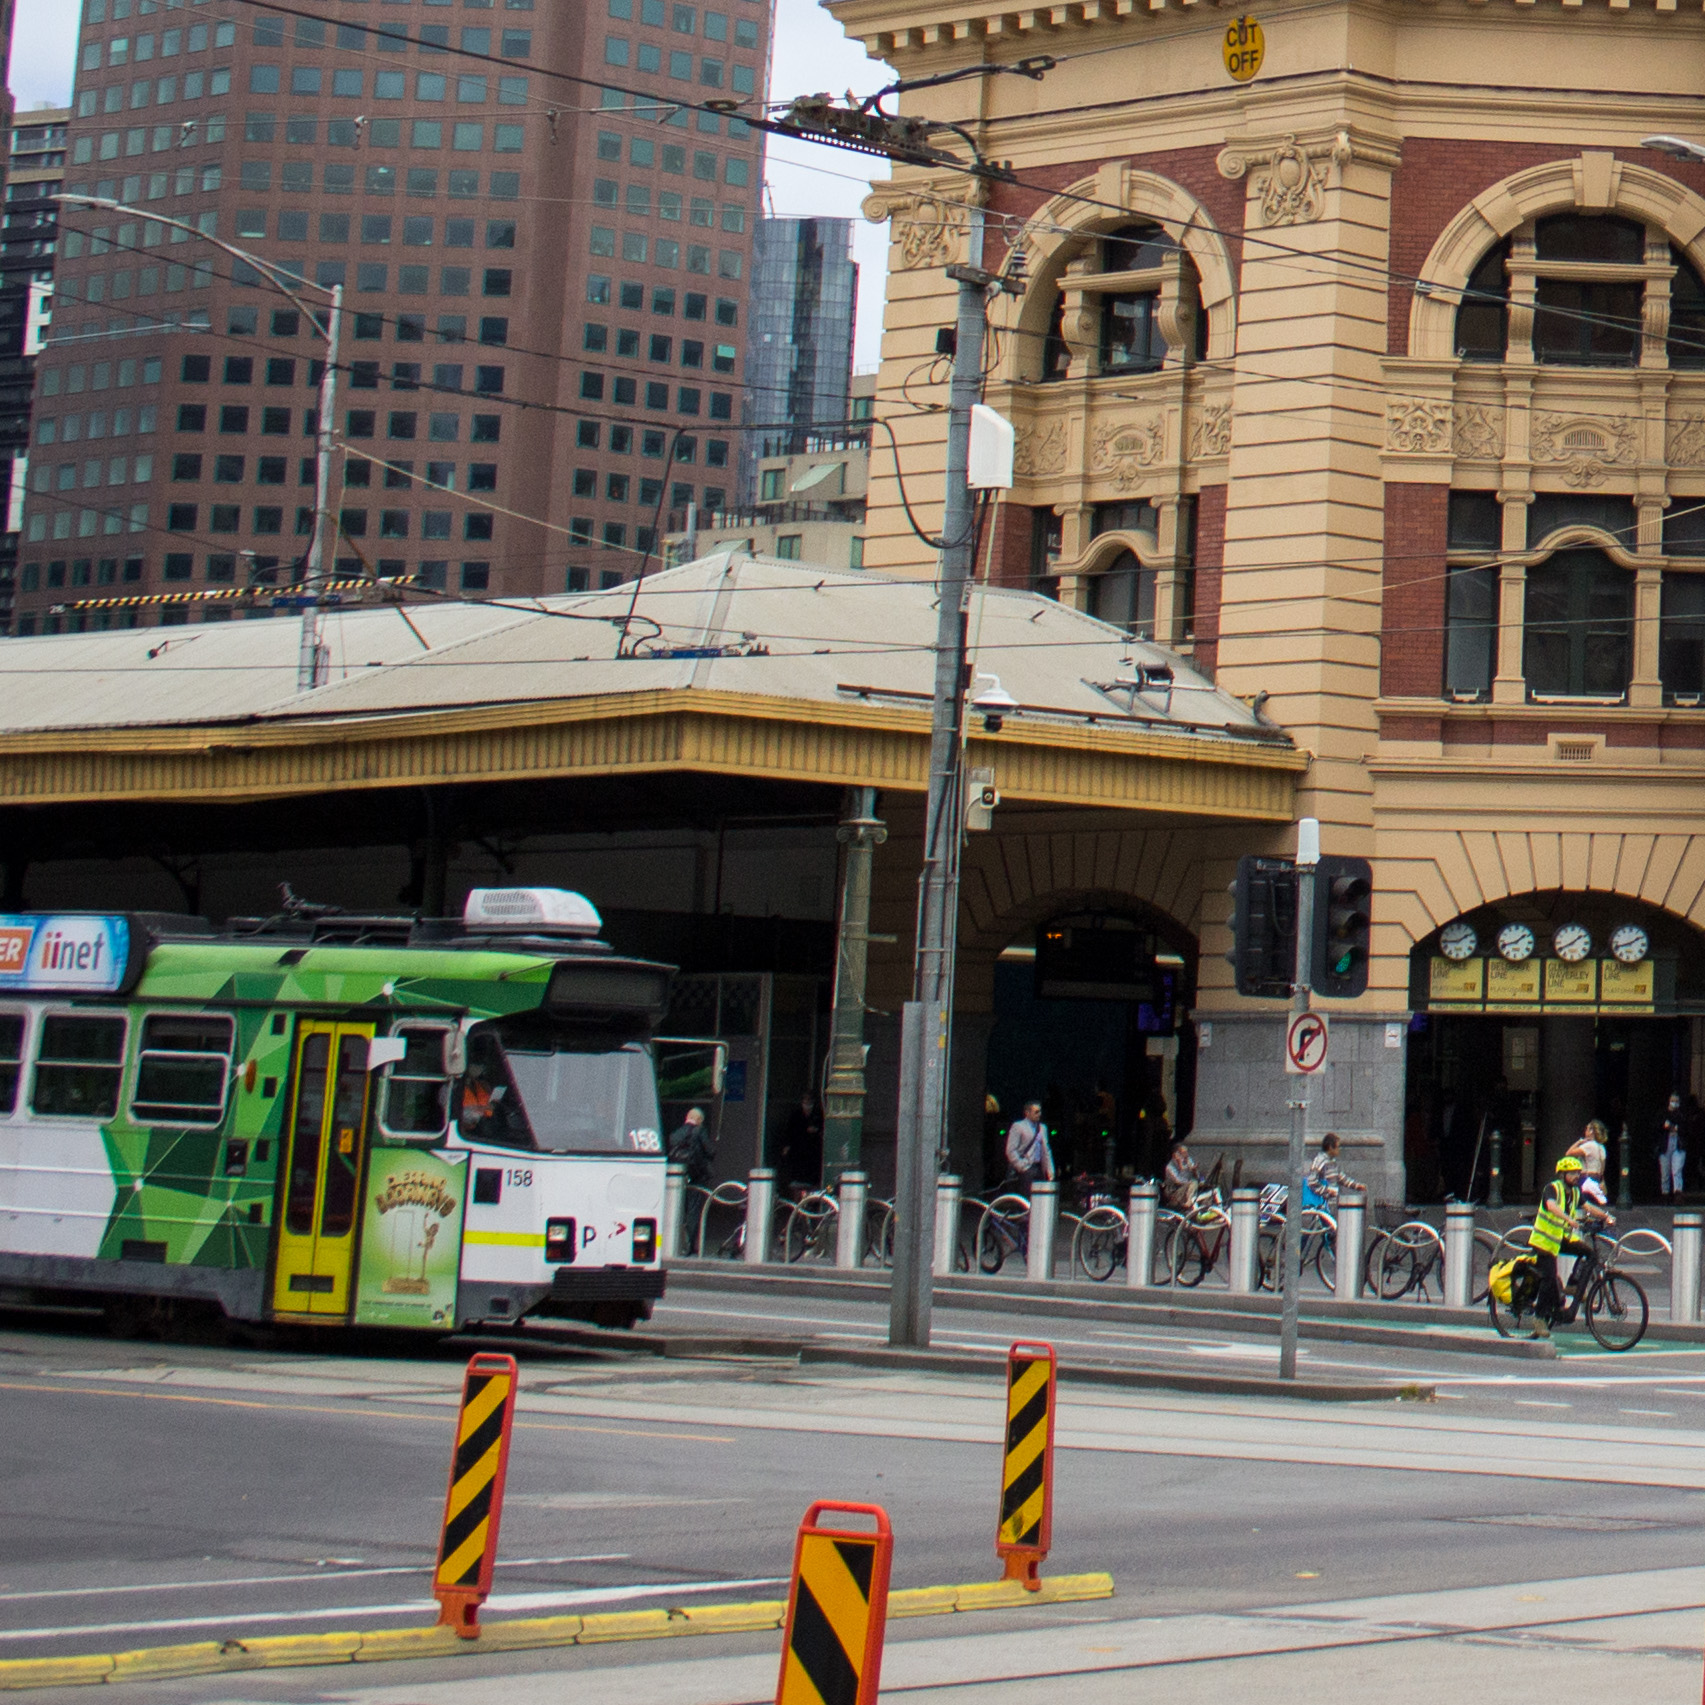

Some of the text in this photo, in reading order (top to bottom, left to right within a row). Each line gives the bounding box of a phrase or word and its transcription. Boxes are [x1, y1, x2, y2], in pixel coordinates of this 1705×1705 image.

[1227, 24, 1257, 46] CUT
[1229, 50, 1258, 73] OFF
[41, 931, 105, 970] iinet
[629, 1128, 661, 1151] 158
[506, 1169, 533, 1187] 158
